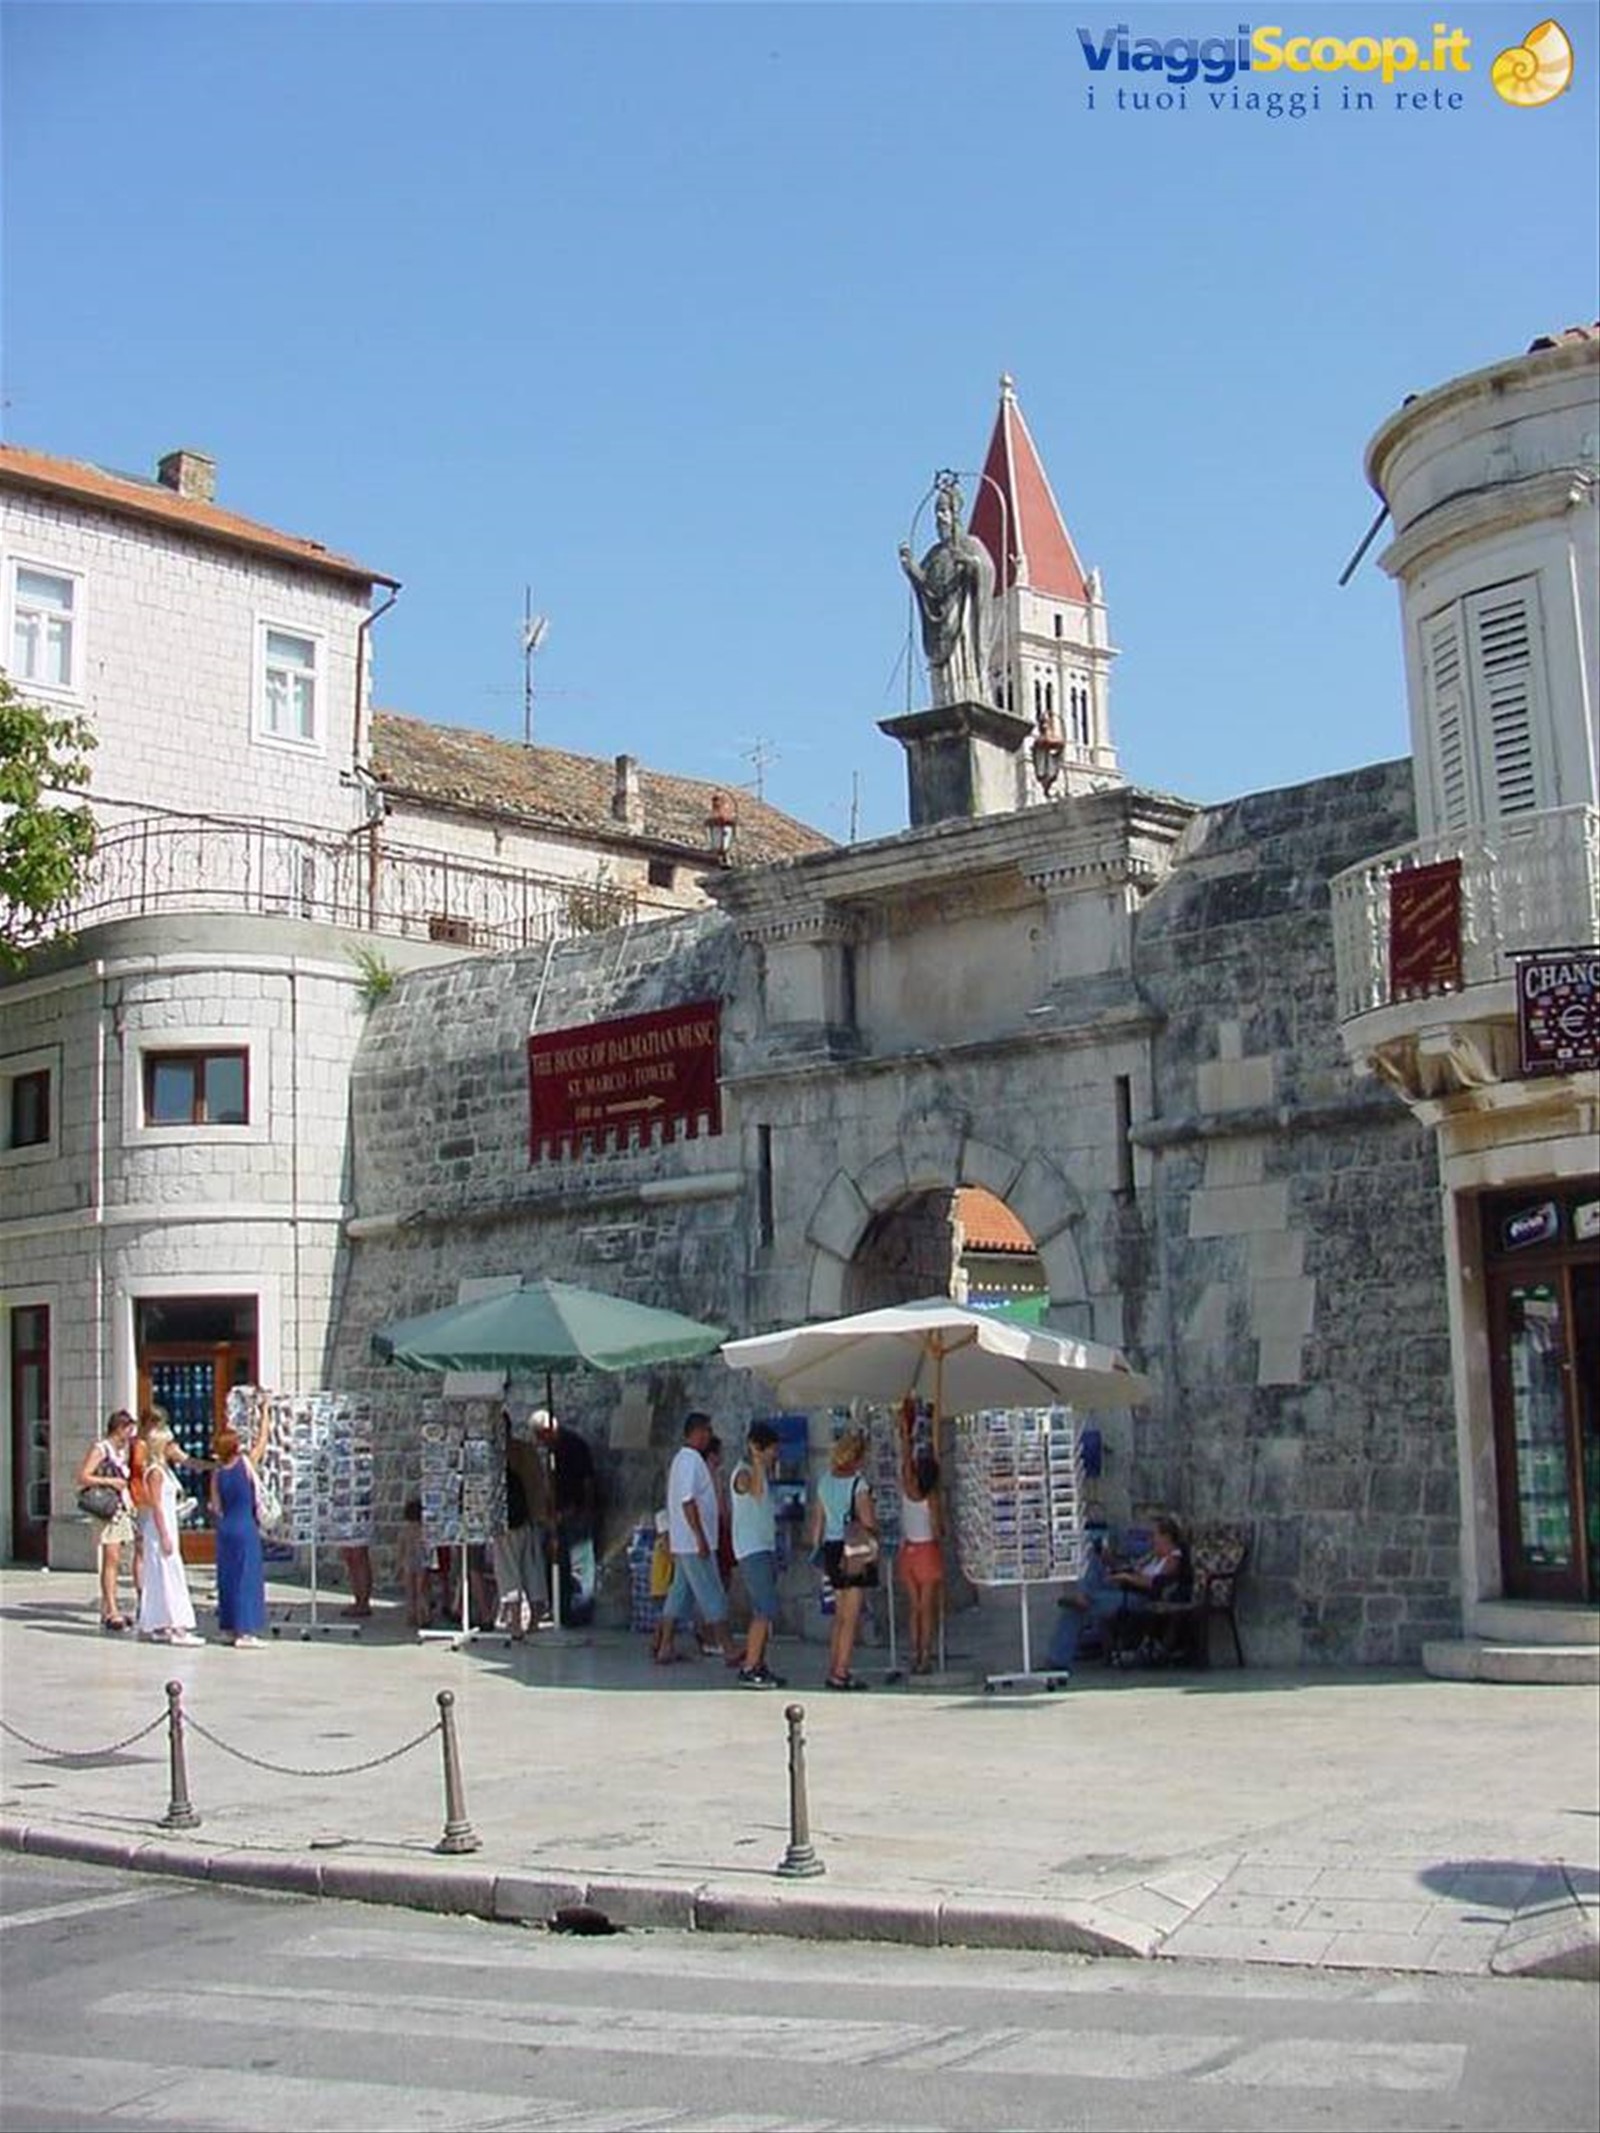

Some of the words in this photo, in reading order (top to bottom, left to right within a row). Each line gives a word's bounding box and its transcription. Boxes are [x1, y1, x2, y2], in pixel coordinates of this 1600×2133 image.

[532, 1051, 553, 1076] THE
[554, 1043, 590, 1073] HOUSE
[591, 1040, 606, 1067] OF
[607, 1027, 676, 1064] DALMATIAN
[635, 1061, 678, 1088] TOWER
